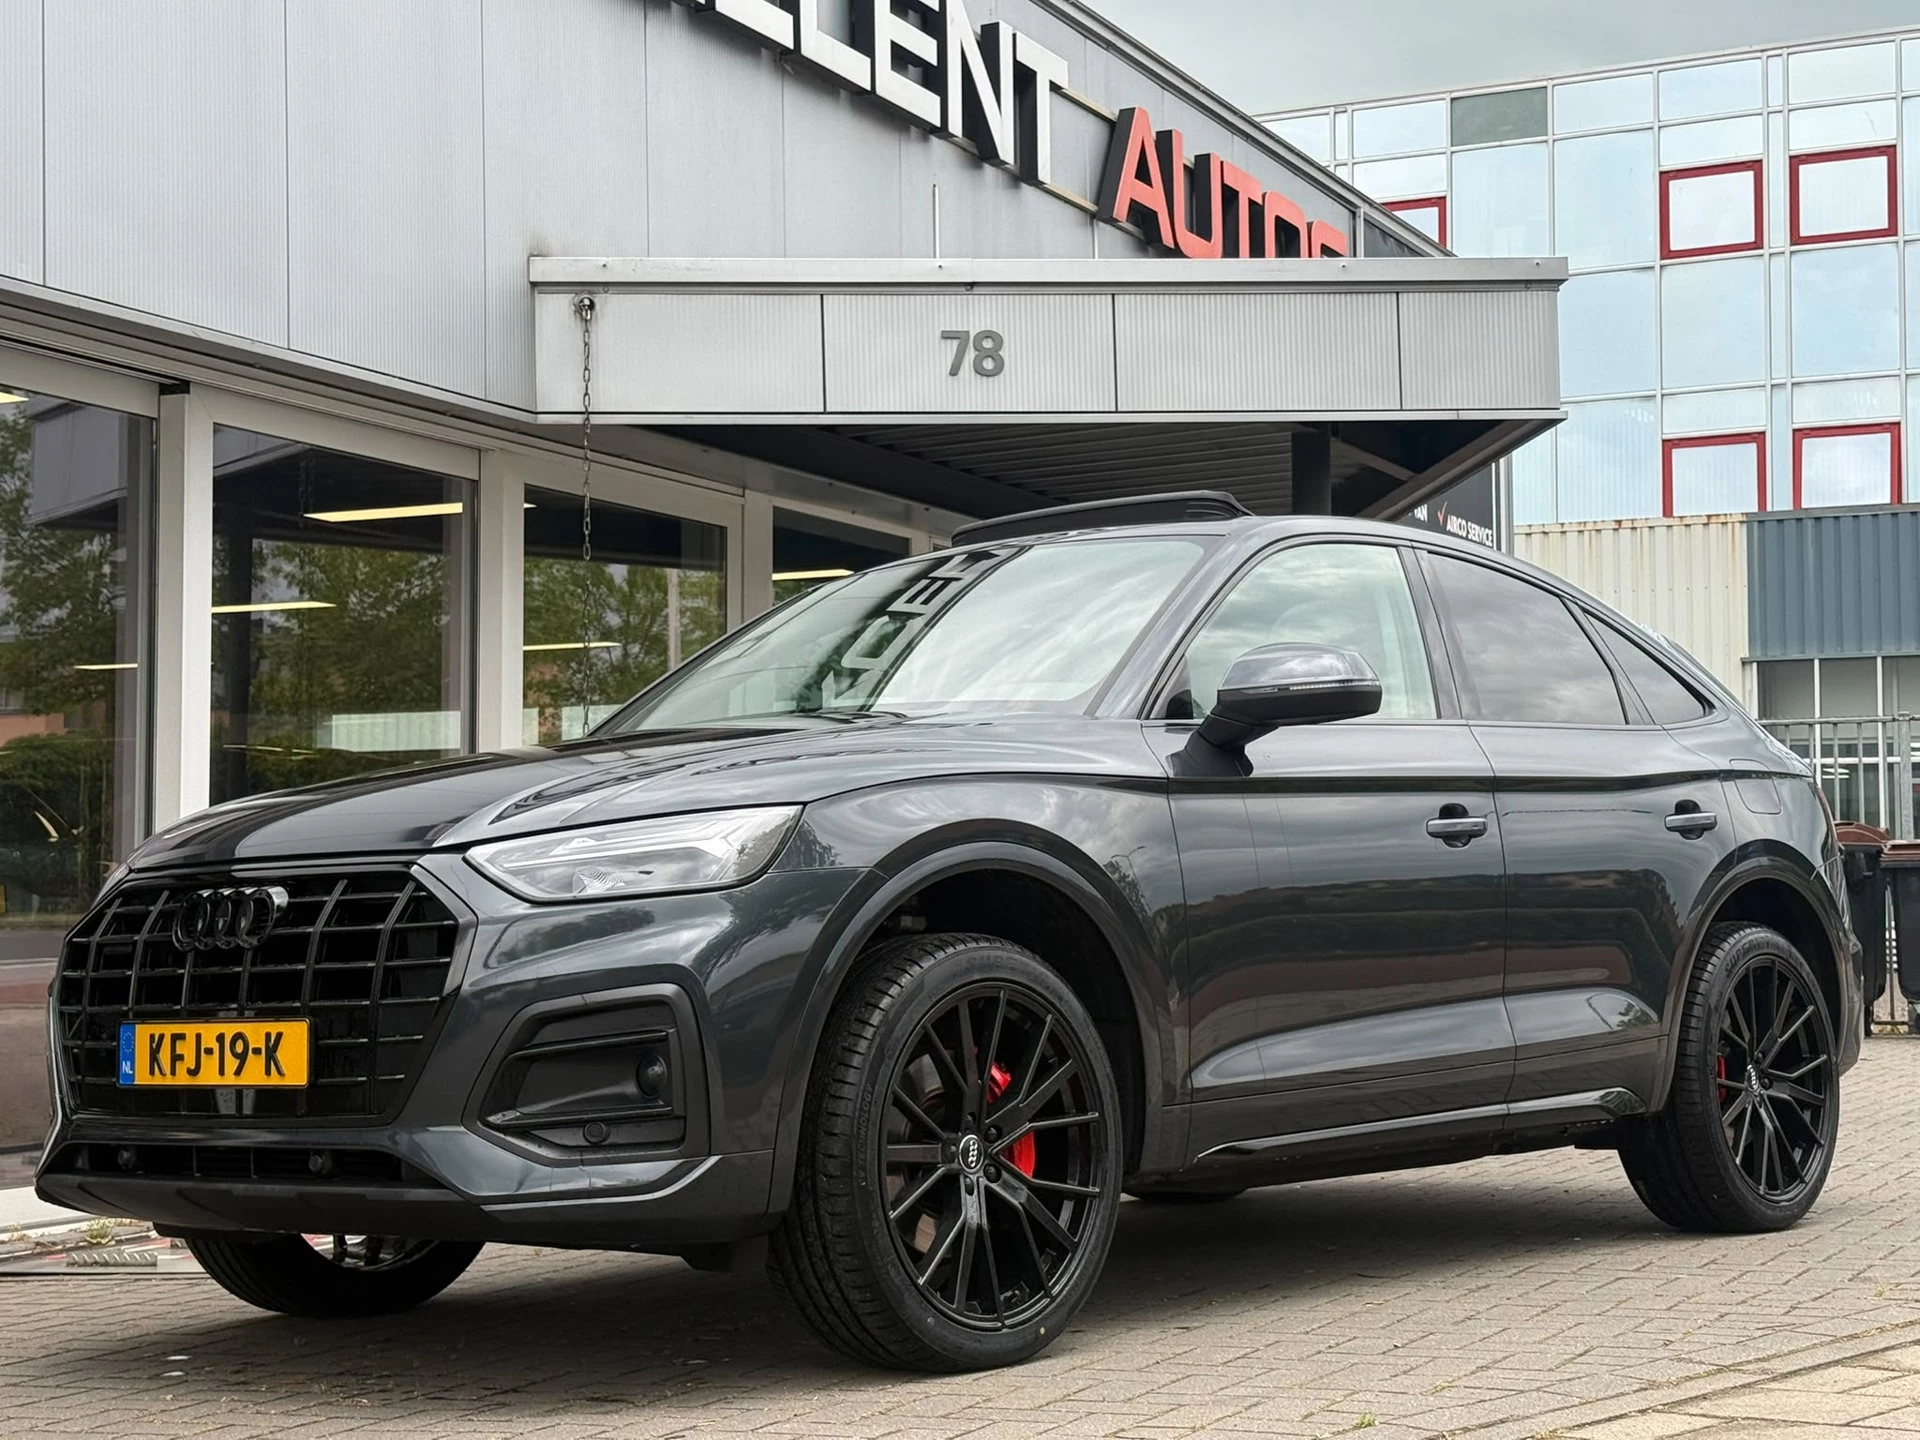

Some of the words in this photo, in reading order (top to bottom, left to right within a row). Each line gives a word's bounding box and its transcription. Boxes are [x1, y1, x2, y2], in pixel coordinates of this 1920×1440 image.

[941, 330, 1005, 377] 78
[1446, 514, 1467, 537] AIRCO
[1467, 521, 1493, 547] SERVICE
[122, 1061, 133, 1074] NL
[148, 1031, 285, 1077] KFJ-19-K
